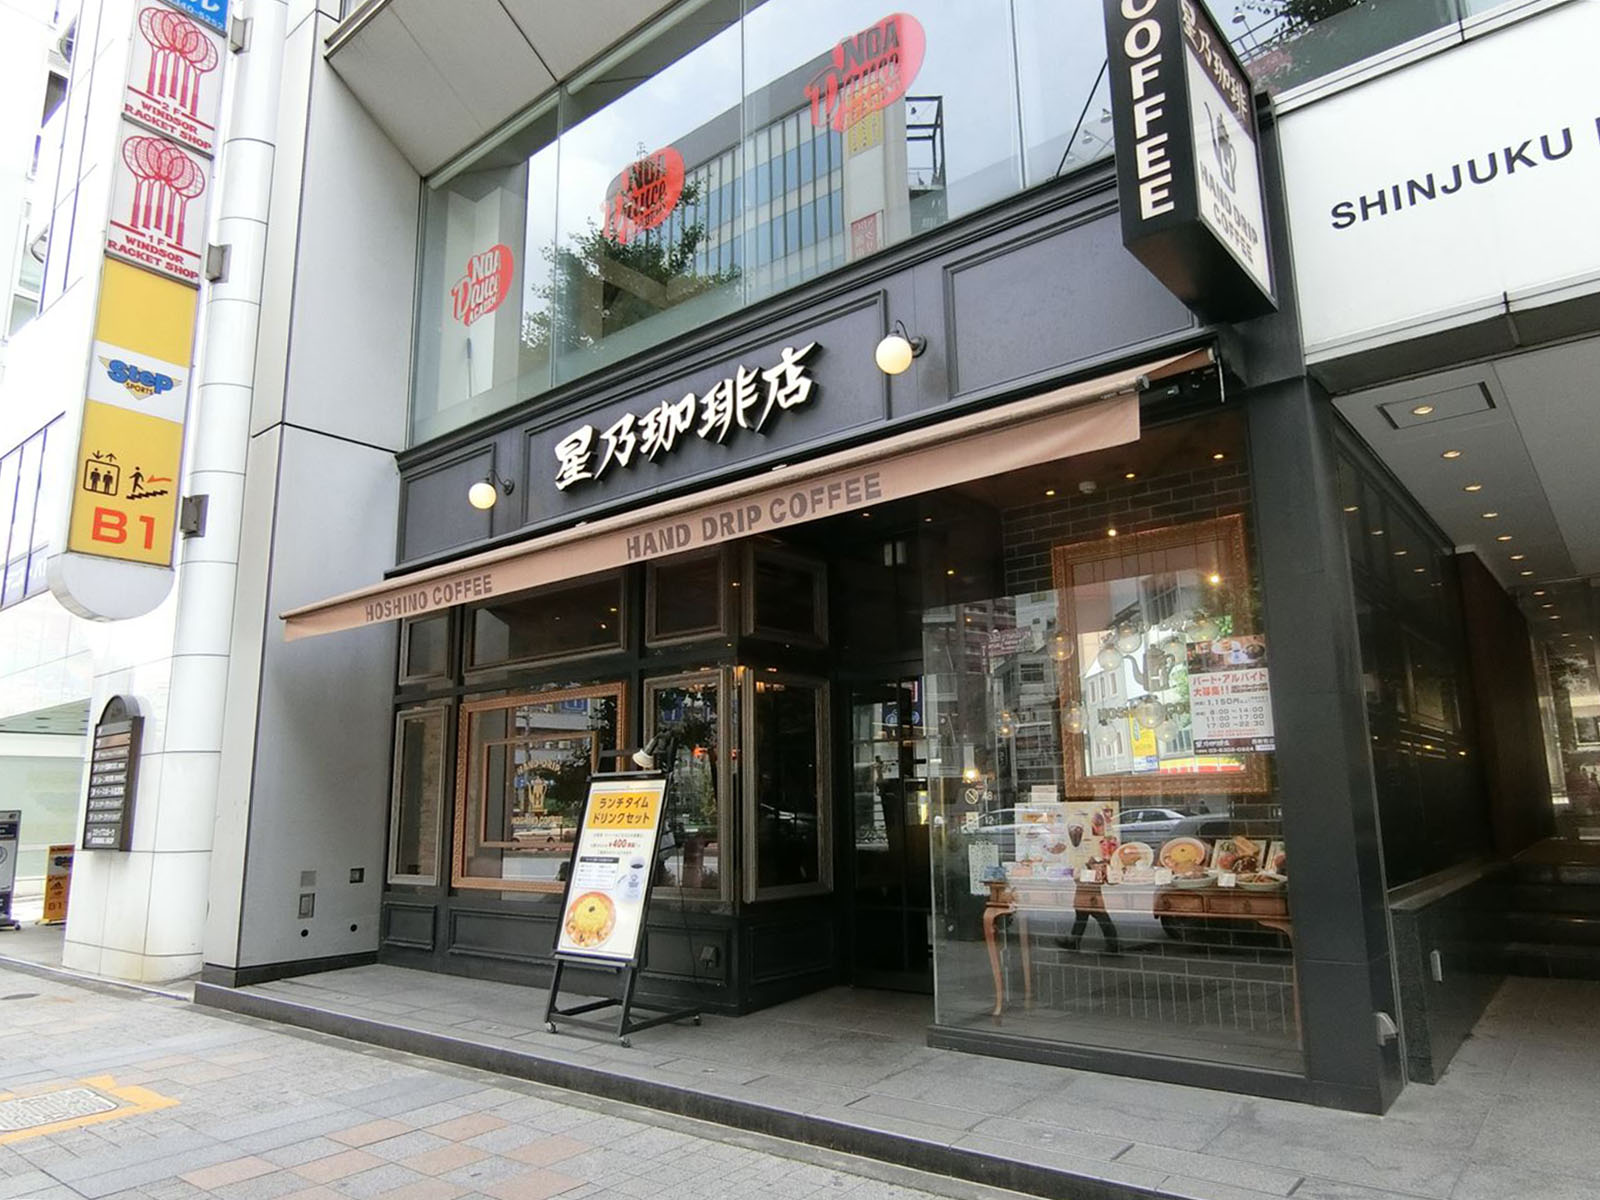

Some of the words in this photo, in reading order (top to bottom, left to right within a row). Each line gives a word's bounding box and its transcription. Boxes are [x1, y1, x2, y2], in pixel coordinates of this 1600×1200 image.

[842, 22, 899, 68] NOA
[124, 103, 177, 133] RACKET
[179, 130, 212, 149] SHOP
[141, 100, 198, 135] WINDSOR
[1330, 127, 1574, 230] SHINJUKU
[1199, 160, 1232, 216] HAND
[1233, 204, 1258, 245] DRIP
[125, 234, 184, 265] WINDSOR
[1213, 202, 1254, 264] COFFEE
[107, 238, 162, 266] RACKET
[165, 261, 199, 279] SHOP
[107, 359, 174, 394] Step
[125, 381, 154, 396] SPORTS
[554, 341, 820, 492] 星乃珈琲店
[626, 522, 692, 560] HAND
[702, 504, 762, 541] DRIP
[769, 472, 882, 524] COFFEE
[364, 590, 428, 621] HOSHINO
[432, 574, 493, 606] COFFEE
[593, 811, 650, 824] ドリンクセット
[600, 796, 649, 809] ランチタイム
